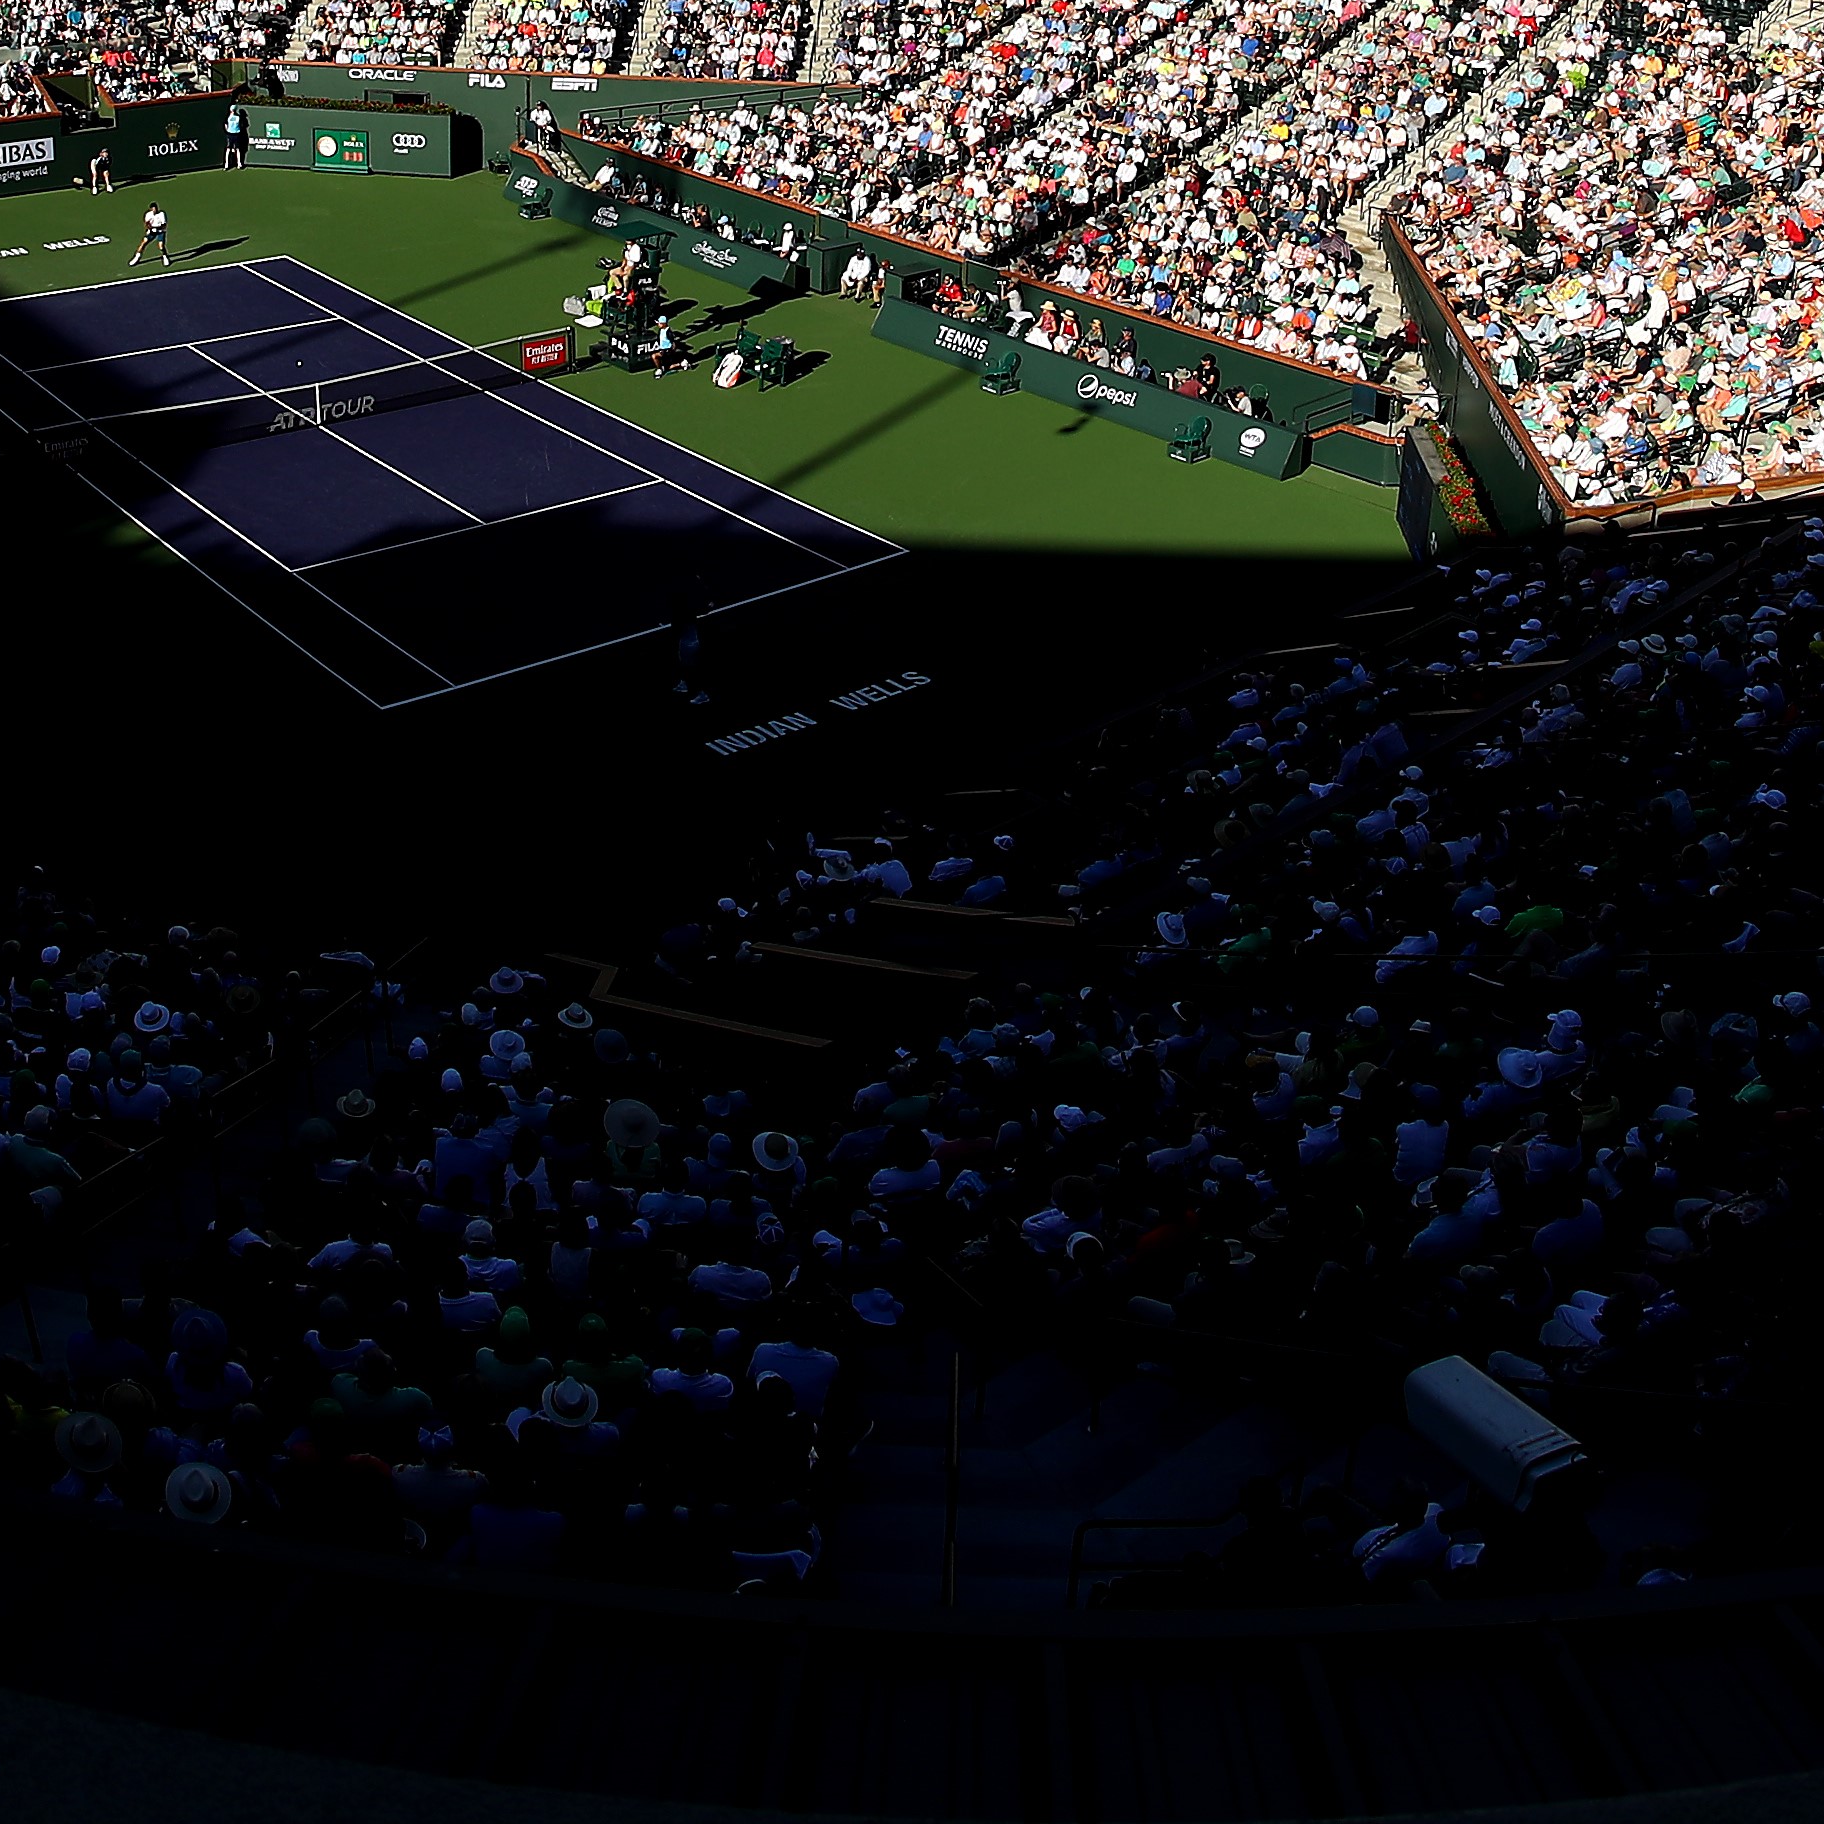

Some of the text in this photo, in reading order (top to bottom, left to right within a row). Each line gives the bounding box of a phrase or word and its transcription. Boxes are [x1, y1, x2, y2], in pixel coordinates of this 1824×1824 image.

[348, 68, 415, 82] ORACLE
[468, 73, 506, 88] FILA
[551, 77, 598, 92] ESPN
[148, 139, 200, 158] ROLEX
[21, 165, 49, 177] world
[42, 234, 112, 252] WELLS
[637, 340, 660, 355] FILA
[936, 325, 989, 354] TENNIS
[525, 342, 564, 358] Emirates
[1095, 383, 1138, 407] pepsi
[320, 394, 377, 418] TOUR
[1244, 433, 1261, 443] WTA
[705, 671, 932, 756] INDIAN WELLS
